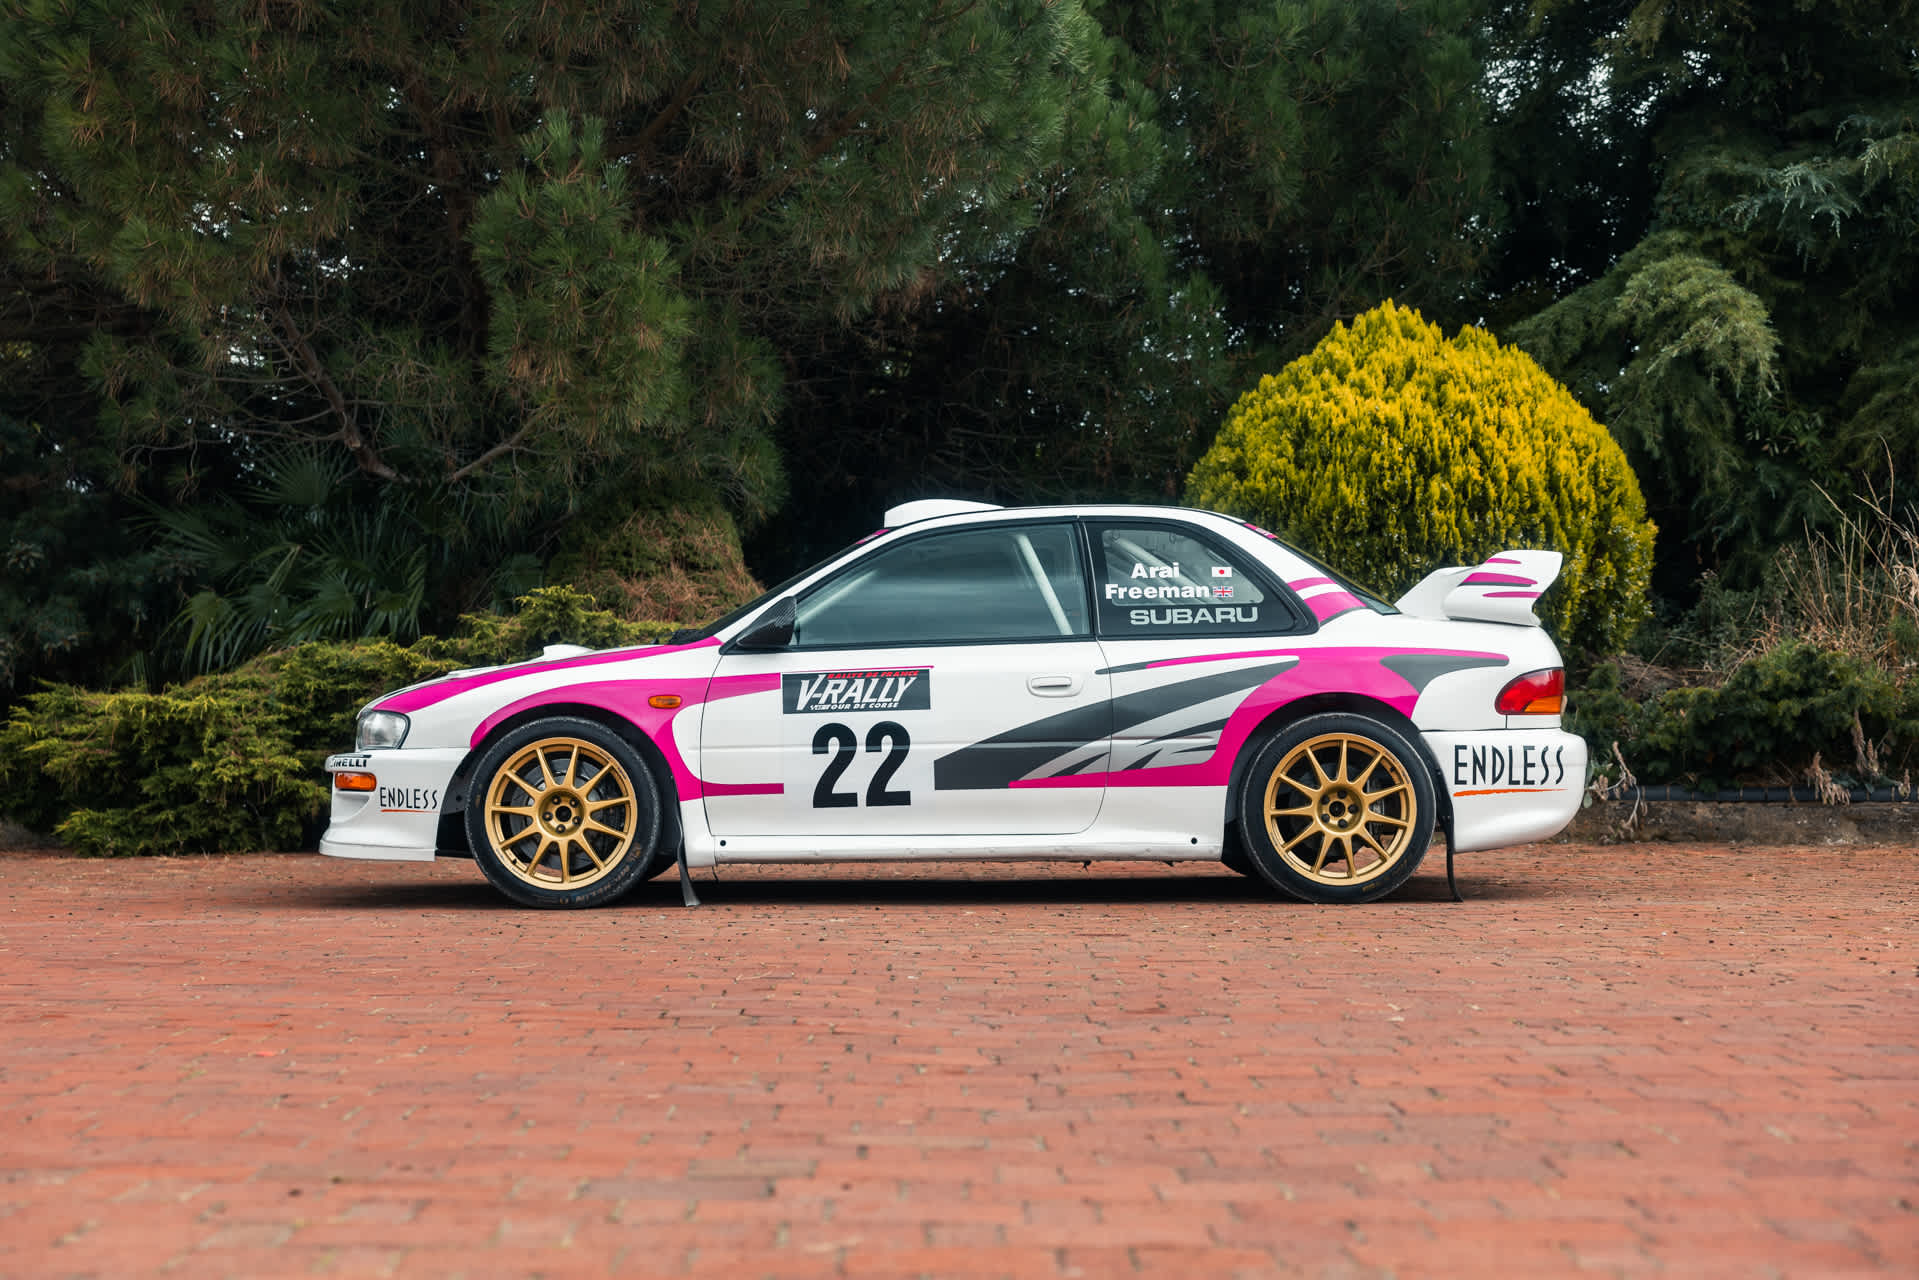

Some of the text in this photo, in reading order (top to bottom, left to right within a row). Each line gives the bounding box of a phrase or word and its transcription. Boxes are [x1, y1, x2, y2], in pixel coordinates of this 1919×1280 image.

[1131, 562, 1180, 579] Arai
[1105, 583, 1210, 600] Freeman
[1130, 606, 1259, 626] SUBARU
[796, 674, 917, 711] V-RALLY
[330, 758, 367, 768] IRELLI
[812, 720, 912, 809] 22
[1454, 744, 1564, 786] ENDLESS
[379, 786, 438, 810] ENDLESS
